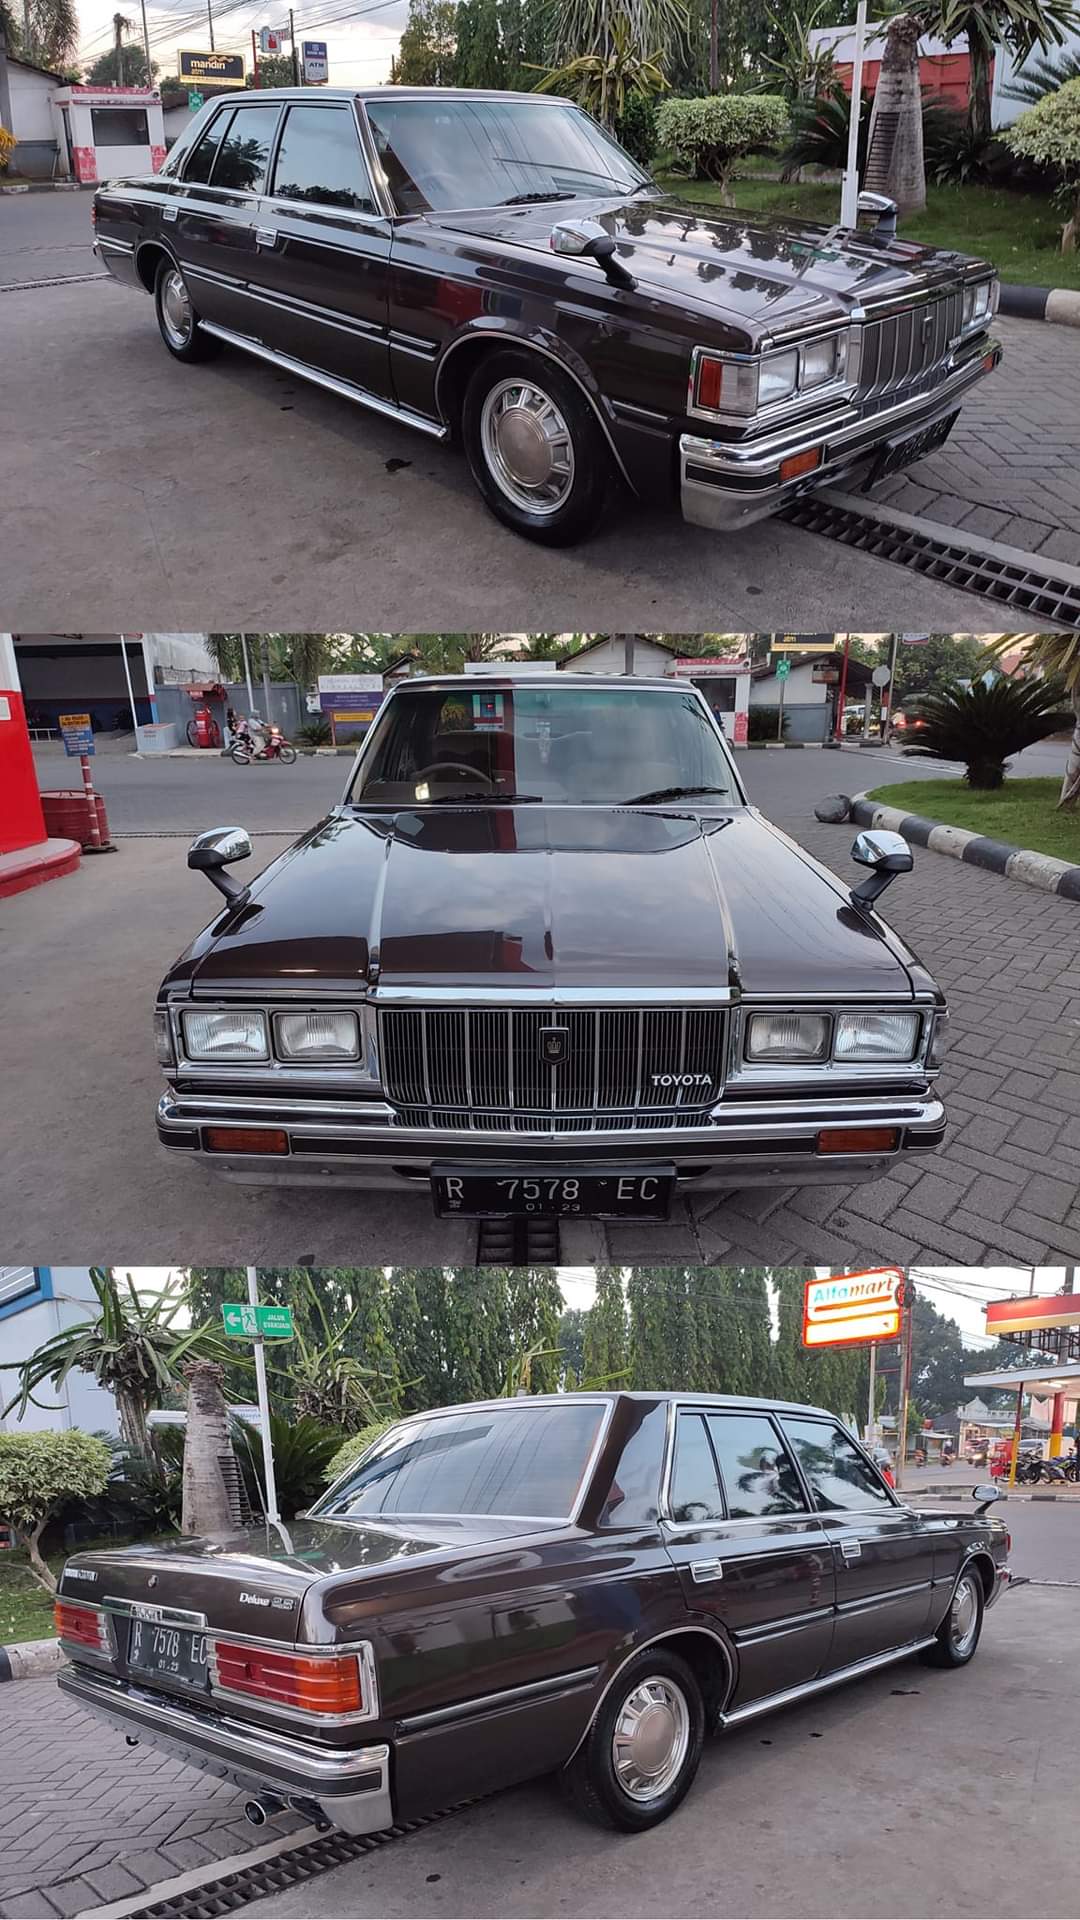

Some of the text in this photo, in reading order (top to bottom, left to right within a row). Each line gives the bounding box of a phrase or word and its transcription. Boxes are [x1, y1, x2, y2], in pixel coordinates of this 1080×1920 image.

[651, 1074, 713, 1086] TOYOTA
[446, 1177, 659, 1200] R 7578 EC
[814, 1277, 894, 1302] Alfamart
[134, 1621, 207, 1665] R 7578 EC
